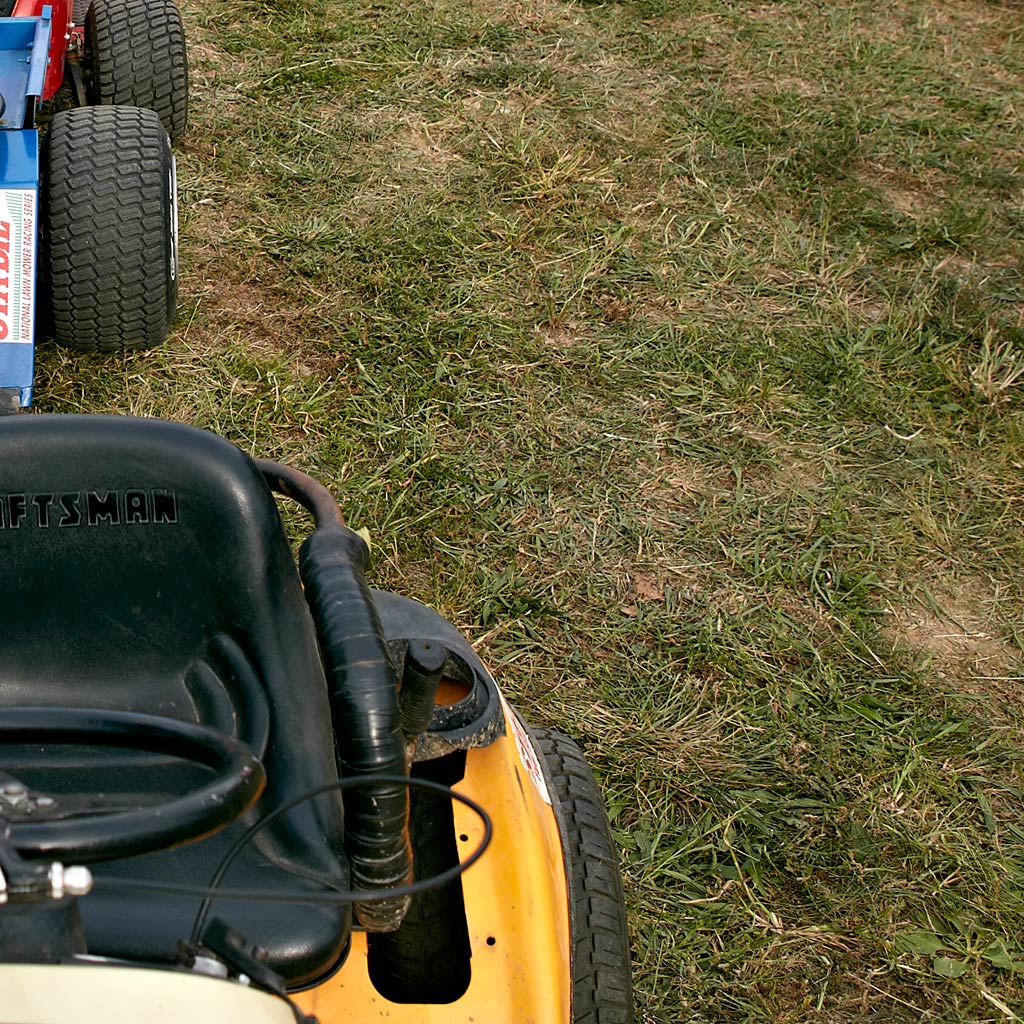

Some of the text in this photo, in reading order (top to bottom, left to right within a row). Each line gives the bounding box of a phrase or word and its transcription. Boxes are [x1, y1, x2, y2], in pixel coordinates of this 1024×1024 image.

[21, 193, 34, 340] NATIONAL LAWN MOWER RACING SERIES
